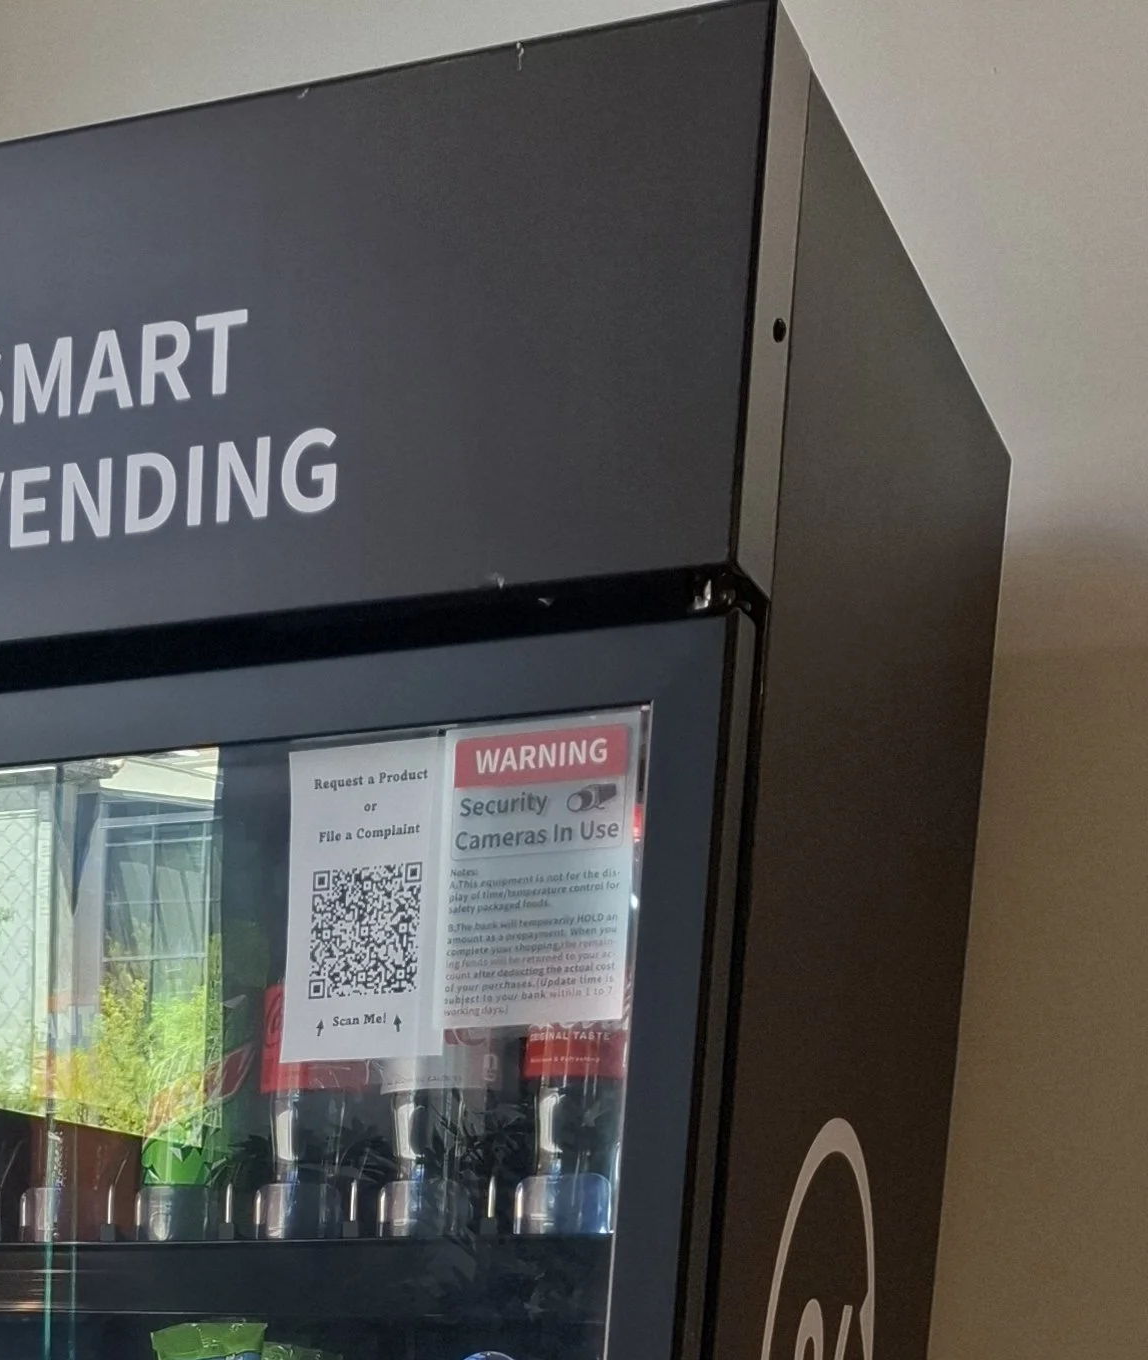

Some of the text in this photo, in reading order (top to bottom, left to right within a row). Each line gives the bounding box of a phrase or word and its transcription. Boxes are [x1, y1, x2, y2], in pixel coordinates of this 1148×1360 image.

[476, 738, 607, 773] WARNING
[314, 769, 428, 791] Request a Product
[364, 803, 377, 812] or
[460, 792, 547, 817] Security
[319, 823, 420, 843] File a Complaint
[455, 821, 619, 851] Cameras In Use
[566, 871, 579, 881] for
[583, 870, 599, 879] the
[577, 913, 603, 922] HOLD
[332, 1013, 386, 1026] Scan Me!
